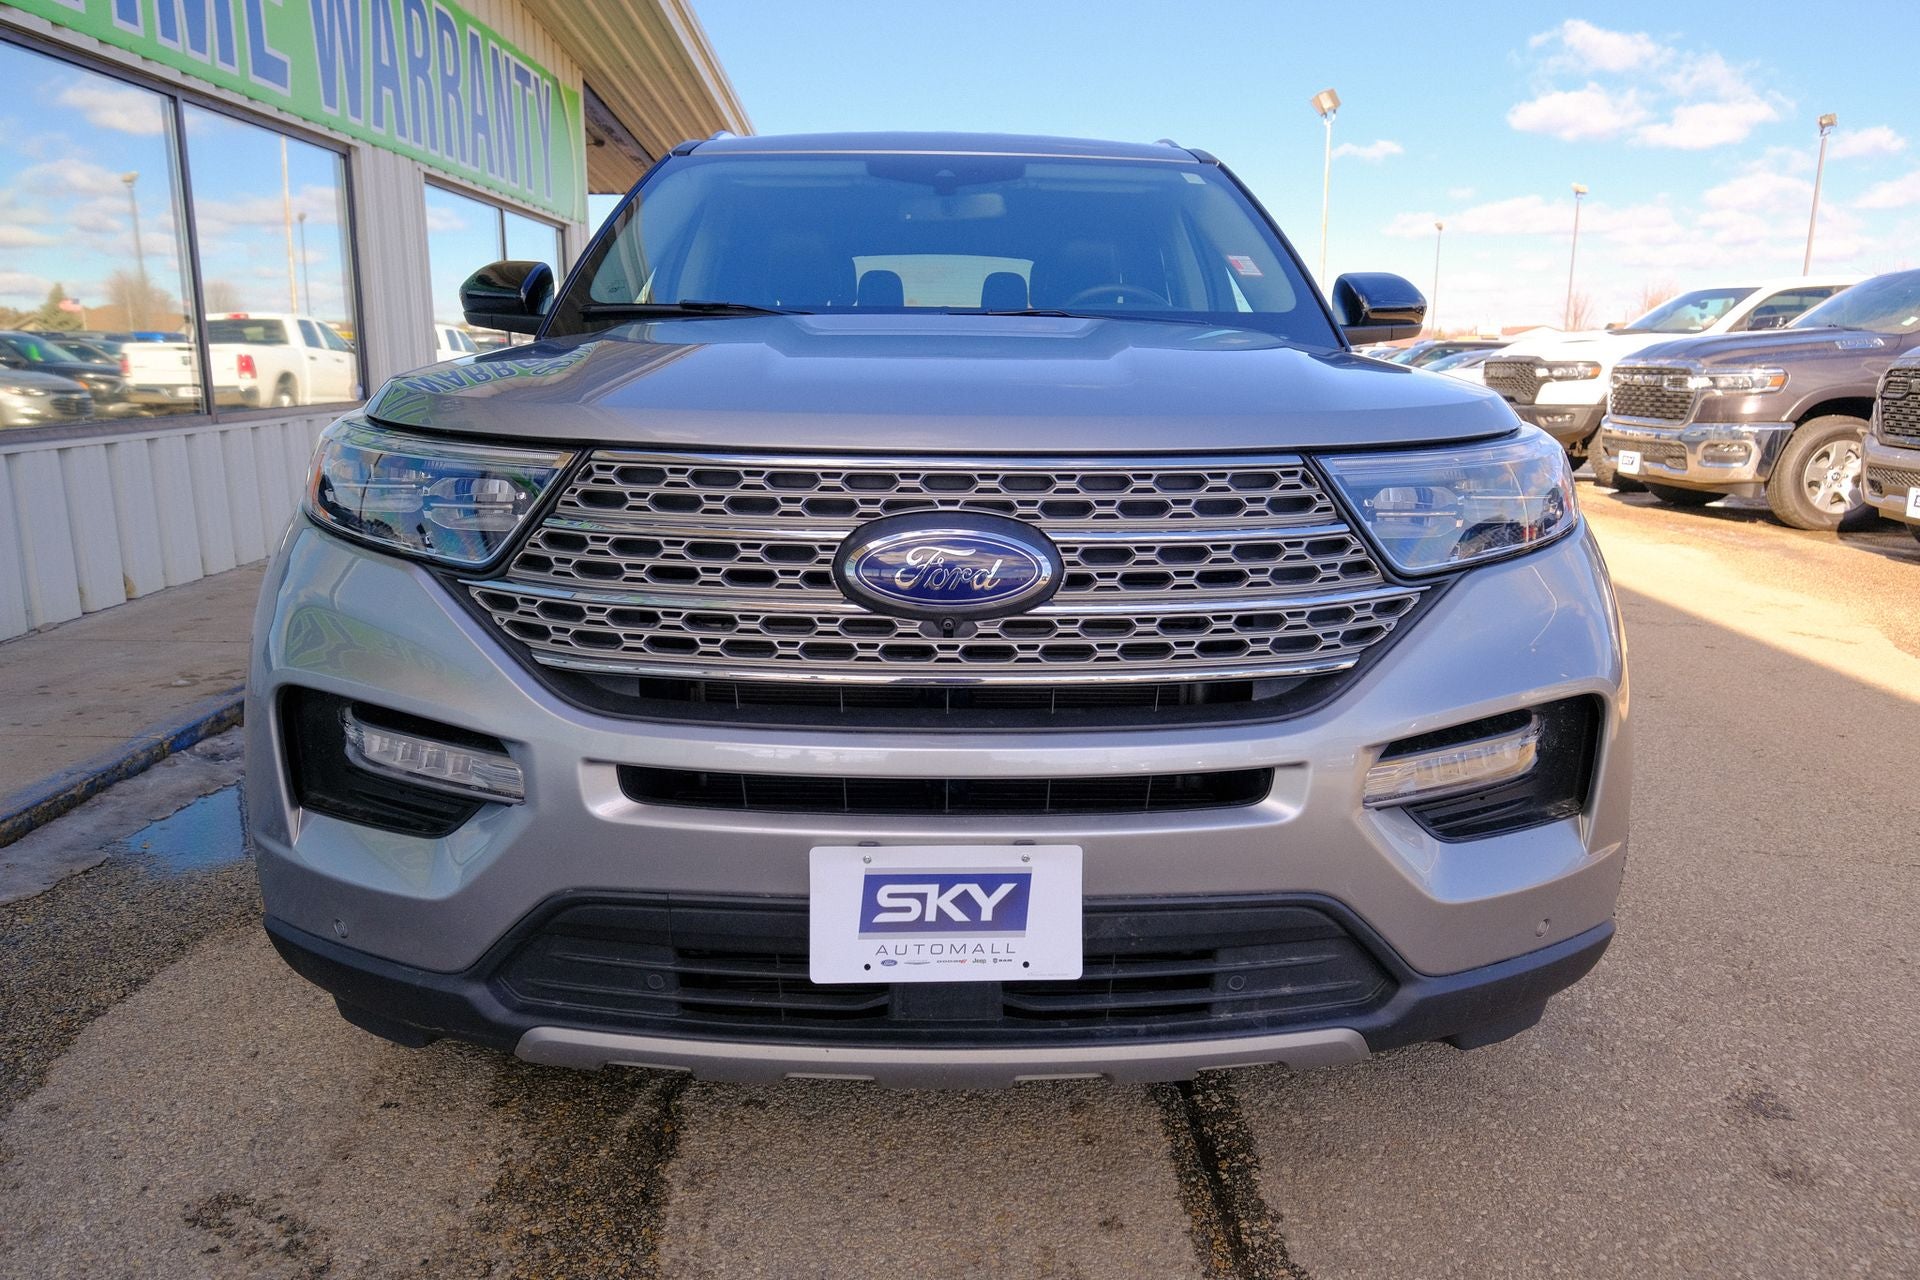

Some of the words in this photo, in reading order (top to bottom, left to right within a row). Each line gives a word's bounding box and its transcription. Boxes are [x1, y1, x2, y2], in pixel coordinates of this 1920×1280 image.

[308, 0, 552, 202] WARRANTY
[895, 546, 1003, 591] Ford
[872, 883, 1018, 923] SKY
[875, 943, 1016, 956] AUTOMALL
